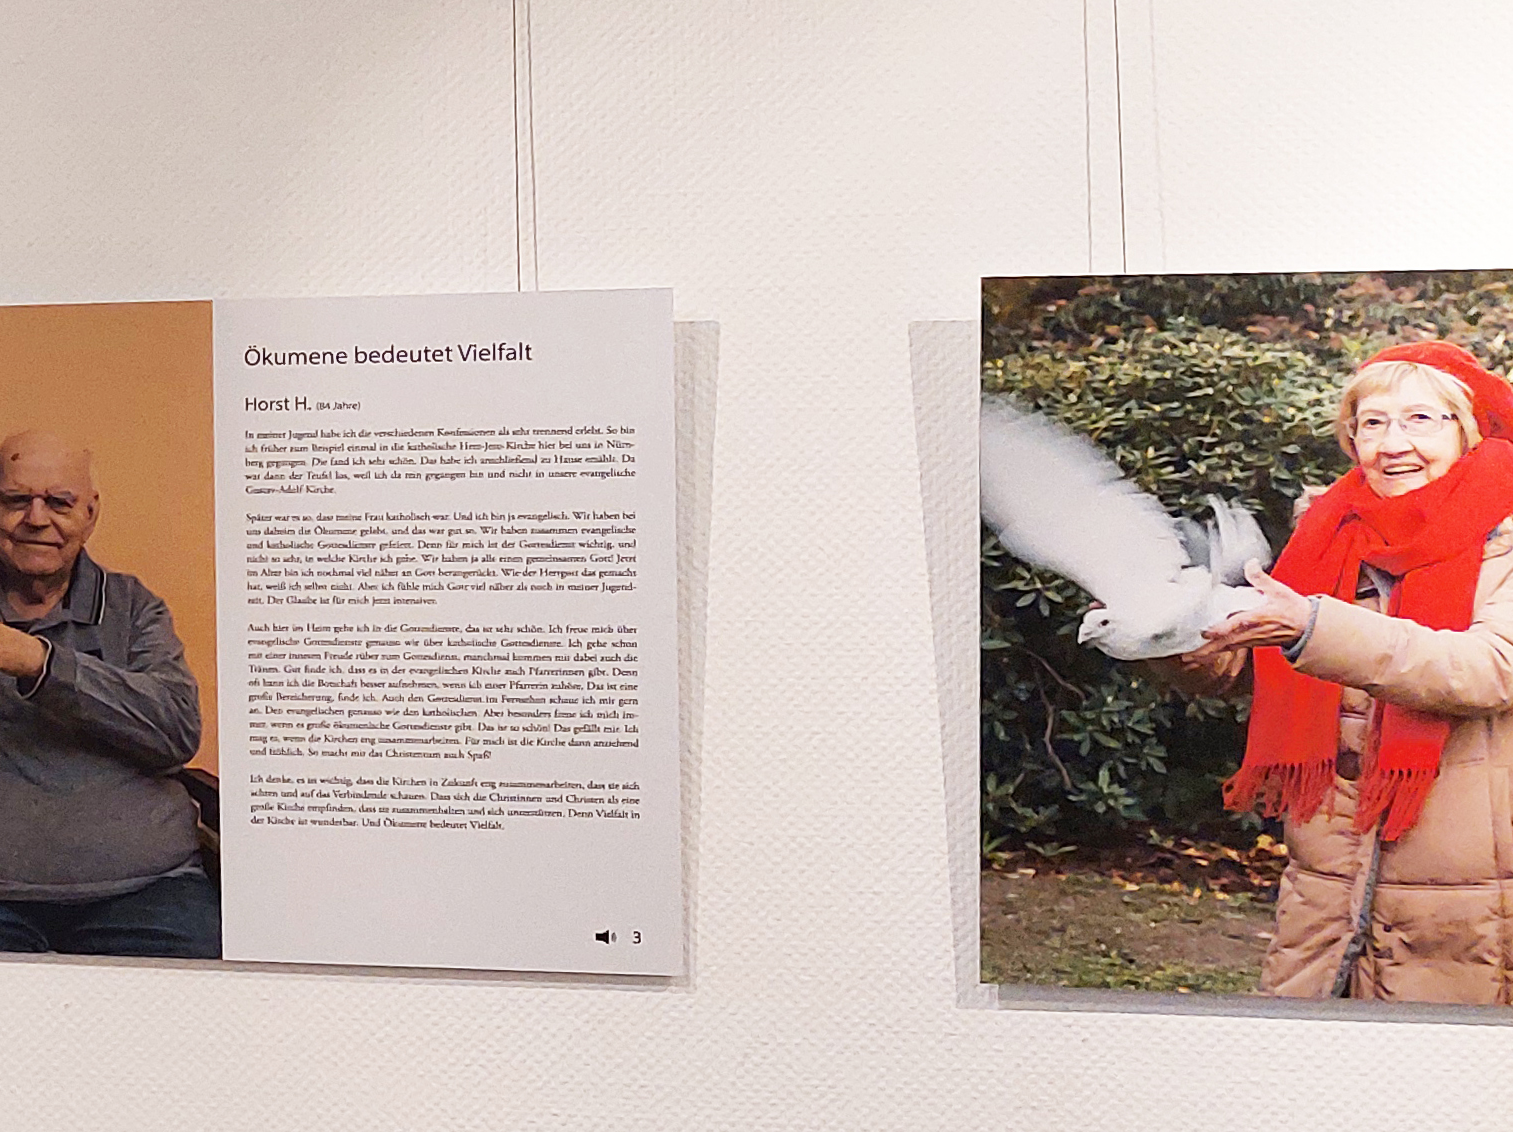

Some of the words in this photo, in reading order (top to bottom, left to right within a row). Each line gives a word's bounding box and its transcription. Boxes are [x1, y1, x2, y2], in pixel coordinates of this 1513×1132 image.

[244, 344, 348, 366] Ökumene
[353, 344, 452, 364] bedeutet
[457, 342, 533, 362] Vielfalt
[245, 396, 290, 411] Horst
[294, 396, 312, 411] H.
[631, 930, 642, 944] 3
